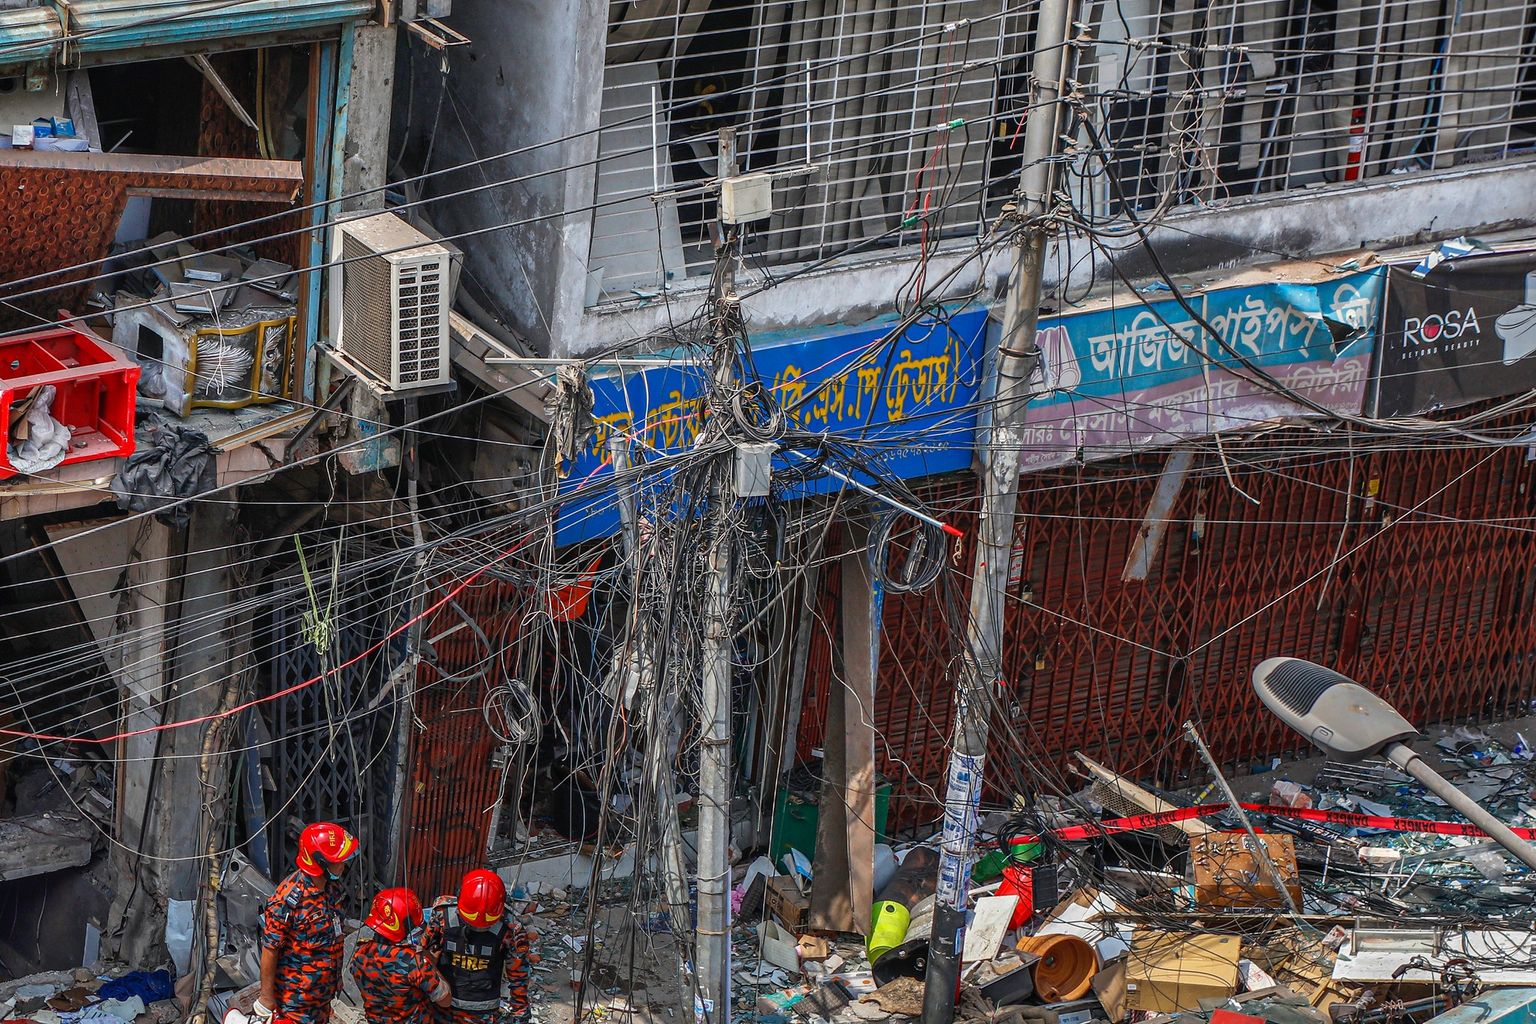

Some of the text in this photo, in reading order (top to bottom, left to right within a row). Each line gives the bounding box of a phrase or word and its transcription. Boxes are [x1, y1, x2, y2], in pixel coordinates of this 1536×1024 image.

[1403, 307, 1480, 347] ROSA
[1088, 311, 1202, 379] আজিজ
[1402, 339, 1480, 360] BEYOND BEAUTY
[1326, 810, 1370, 827] DANGER
[1394, 817, 1438, 834] DANGER
[451, 953, 491, 972] FIRE
